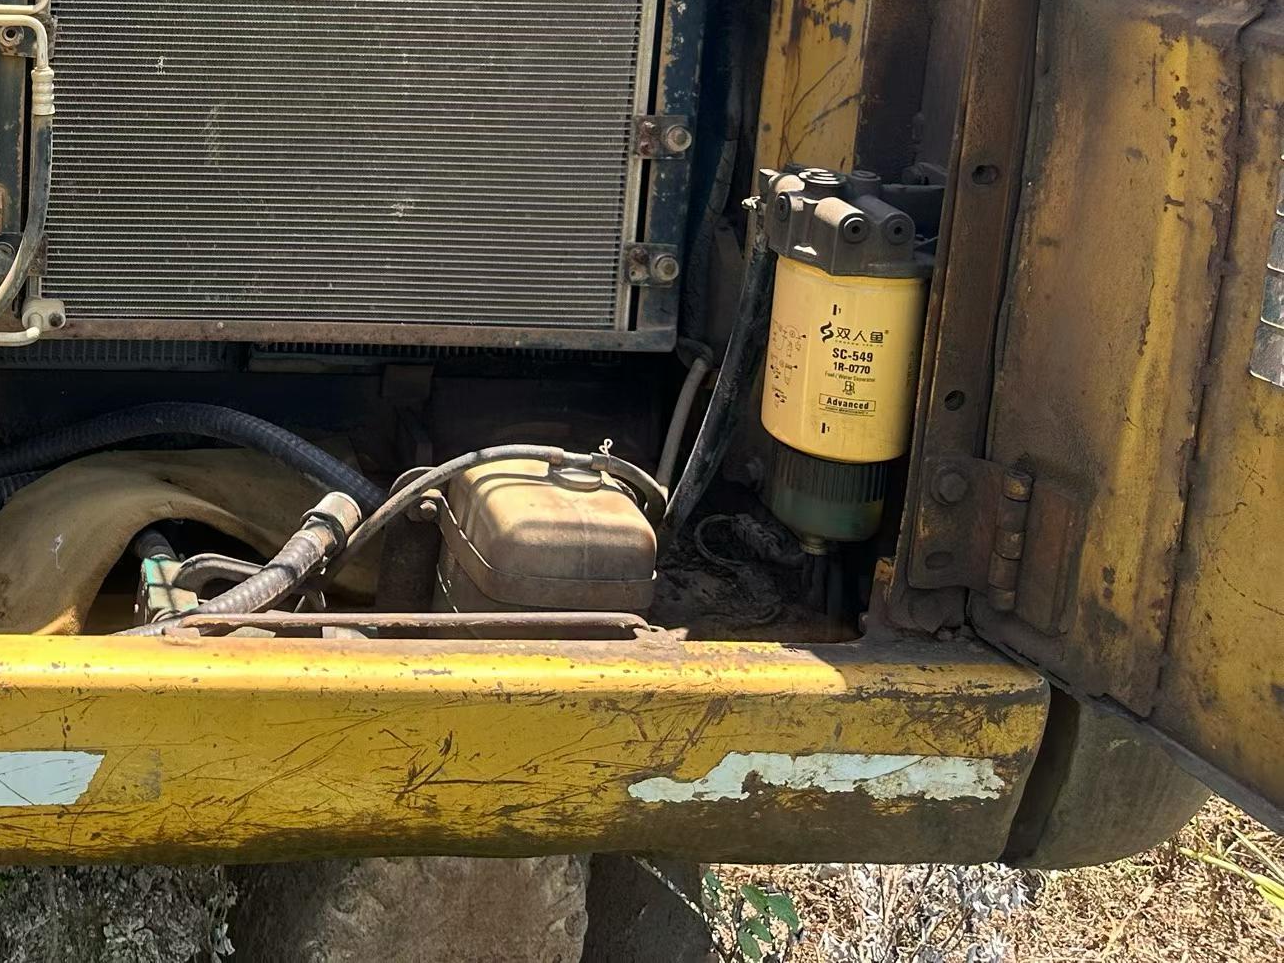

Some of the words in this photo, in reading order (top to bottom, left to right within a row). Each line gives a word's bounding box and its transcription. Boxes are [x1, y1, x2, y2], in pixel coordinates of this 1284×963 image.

[832, 347, 874, 363] SC-549
[833, 361, 871, 375] 1R-0770
[826, 397, 869, 410] Advanced
